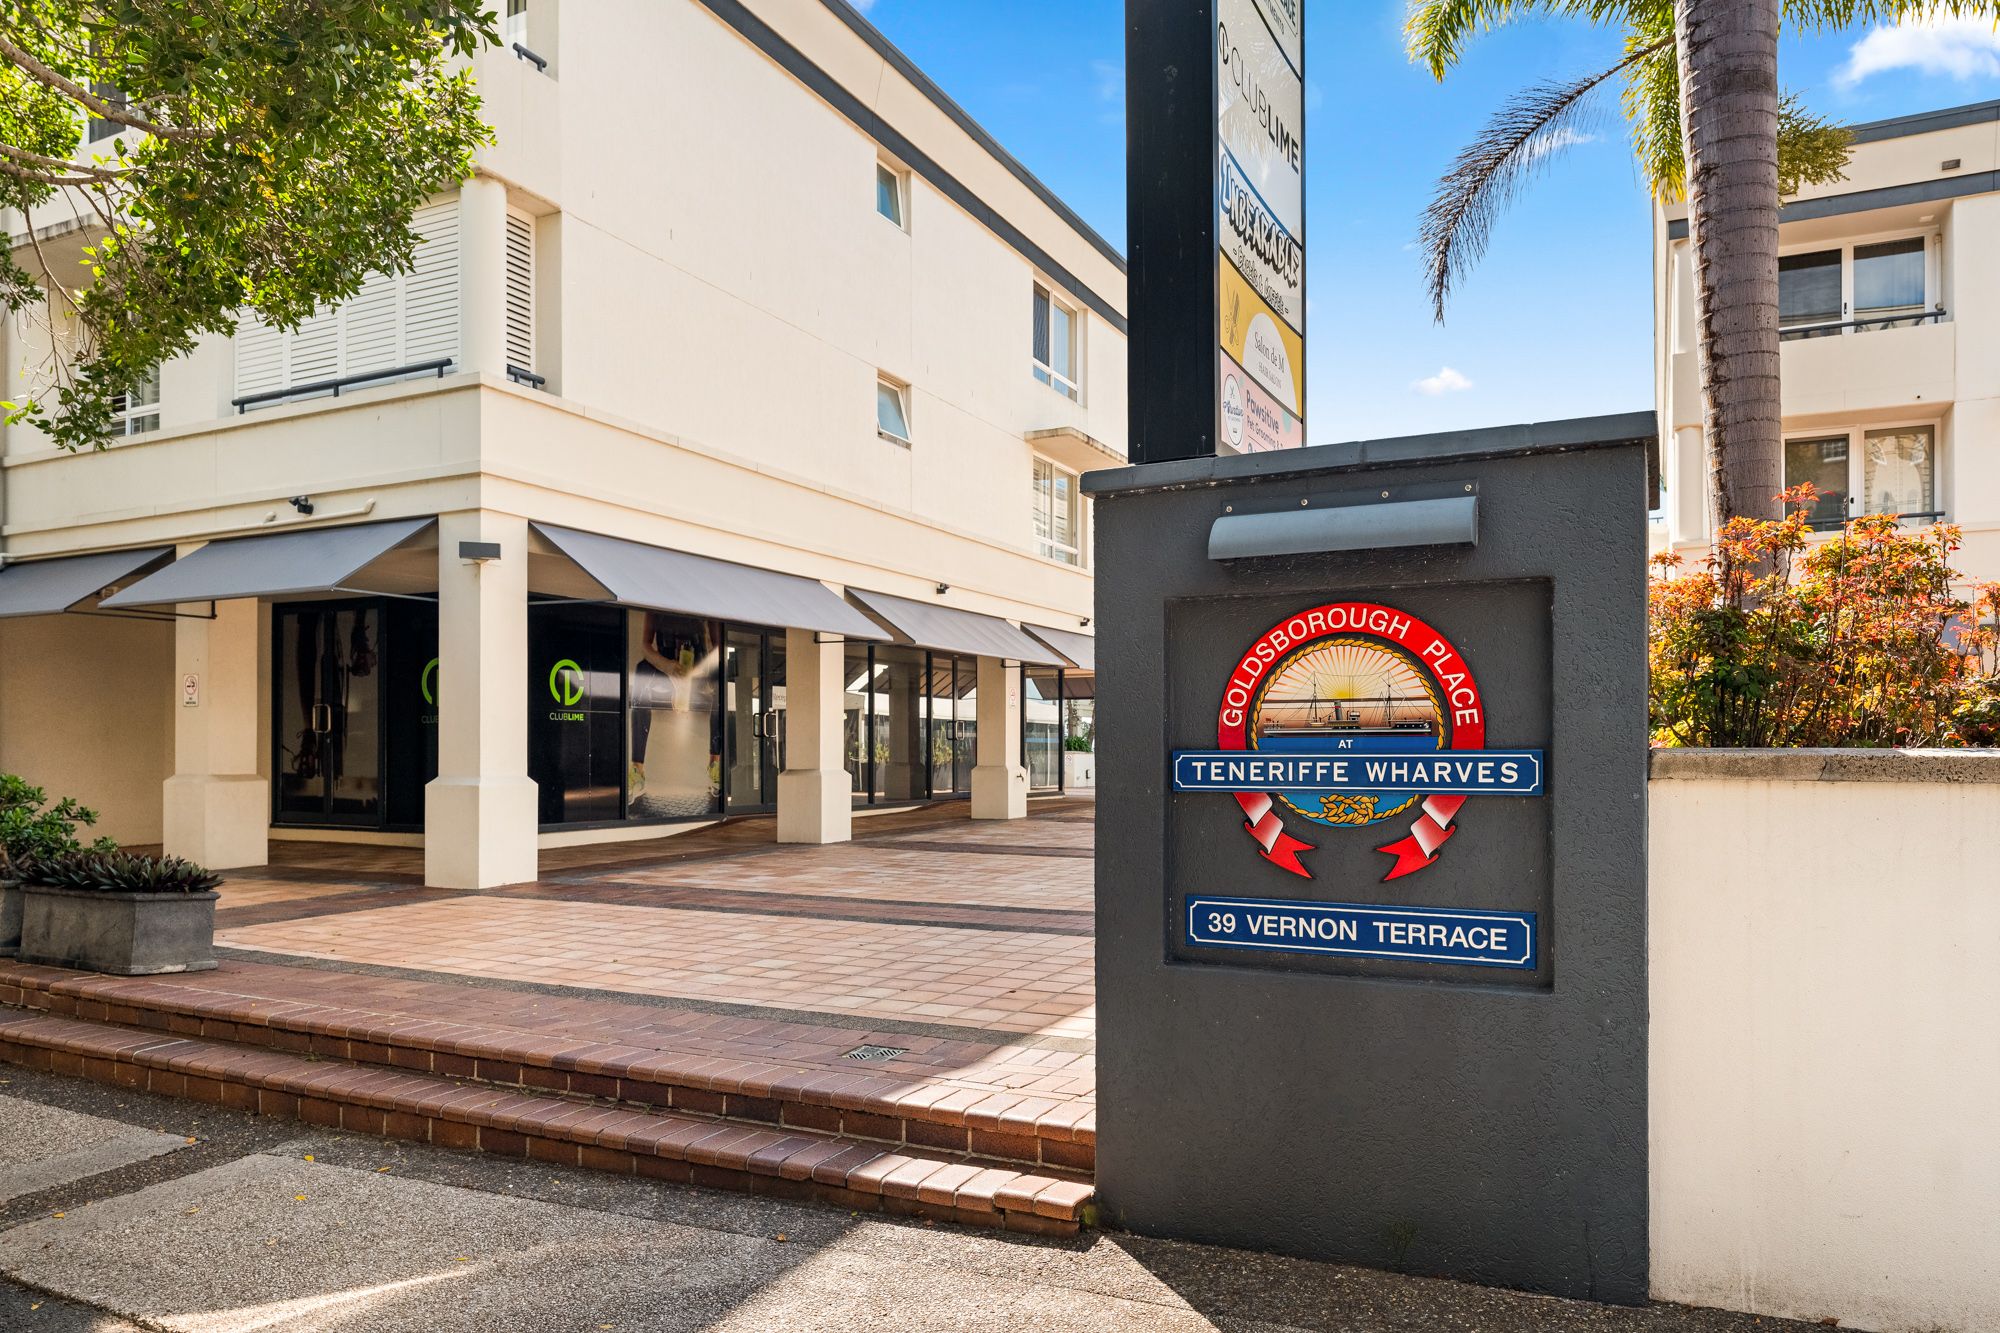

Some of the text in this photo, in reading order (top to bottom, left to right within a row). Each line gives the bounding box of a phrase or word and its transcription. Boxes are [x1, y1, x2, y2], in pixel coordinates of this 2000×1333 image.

[1231, 47, 1299, 175] CLUBLIME
[1220, 153, 1299, 289] UNBEARABLE
[1254, 332, 1285, 373] Salon de M
[1246, 389, 1280, 434] Pawsitive
[1247, 415, 1256, 431] Pet
[1222, 606, 1479, 727] GOLDSBOROUGH PLACE
[549, 712, 584, 721] CLUBLIME
[1338, 740, 1353, 749] AT
[1192, 761, 1519, 784] TENERIFFE WHARVES
[1208, 912, 1508, 951] 39 VERNON TERRACE
